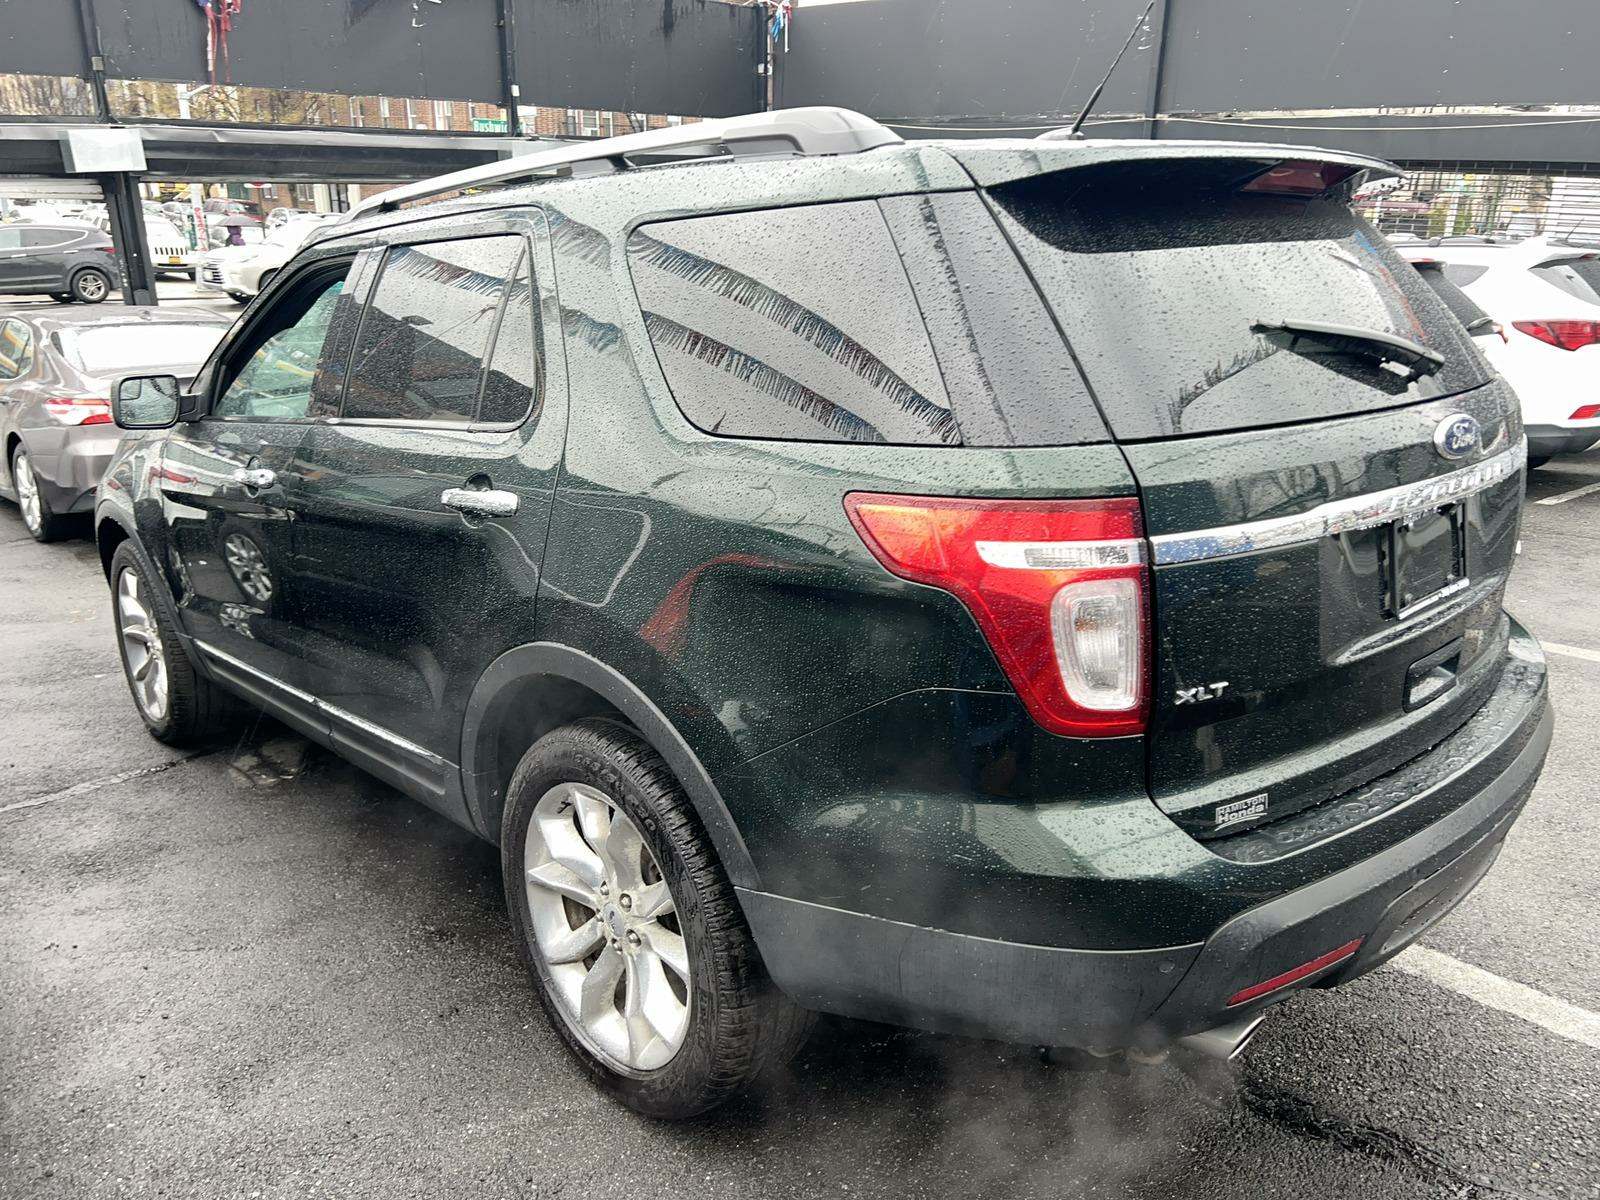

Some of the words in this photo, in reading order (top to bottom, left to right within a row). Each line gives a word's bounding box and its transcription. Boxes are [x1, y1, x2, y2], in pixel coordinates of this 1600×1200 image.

[1175, 681, 1230, 705] XLT
[1218, 804, 1265, 823] Honda
[1219, 796, 1265, 815] HAMILTON
